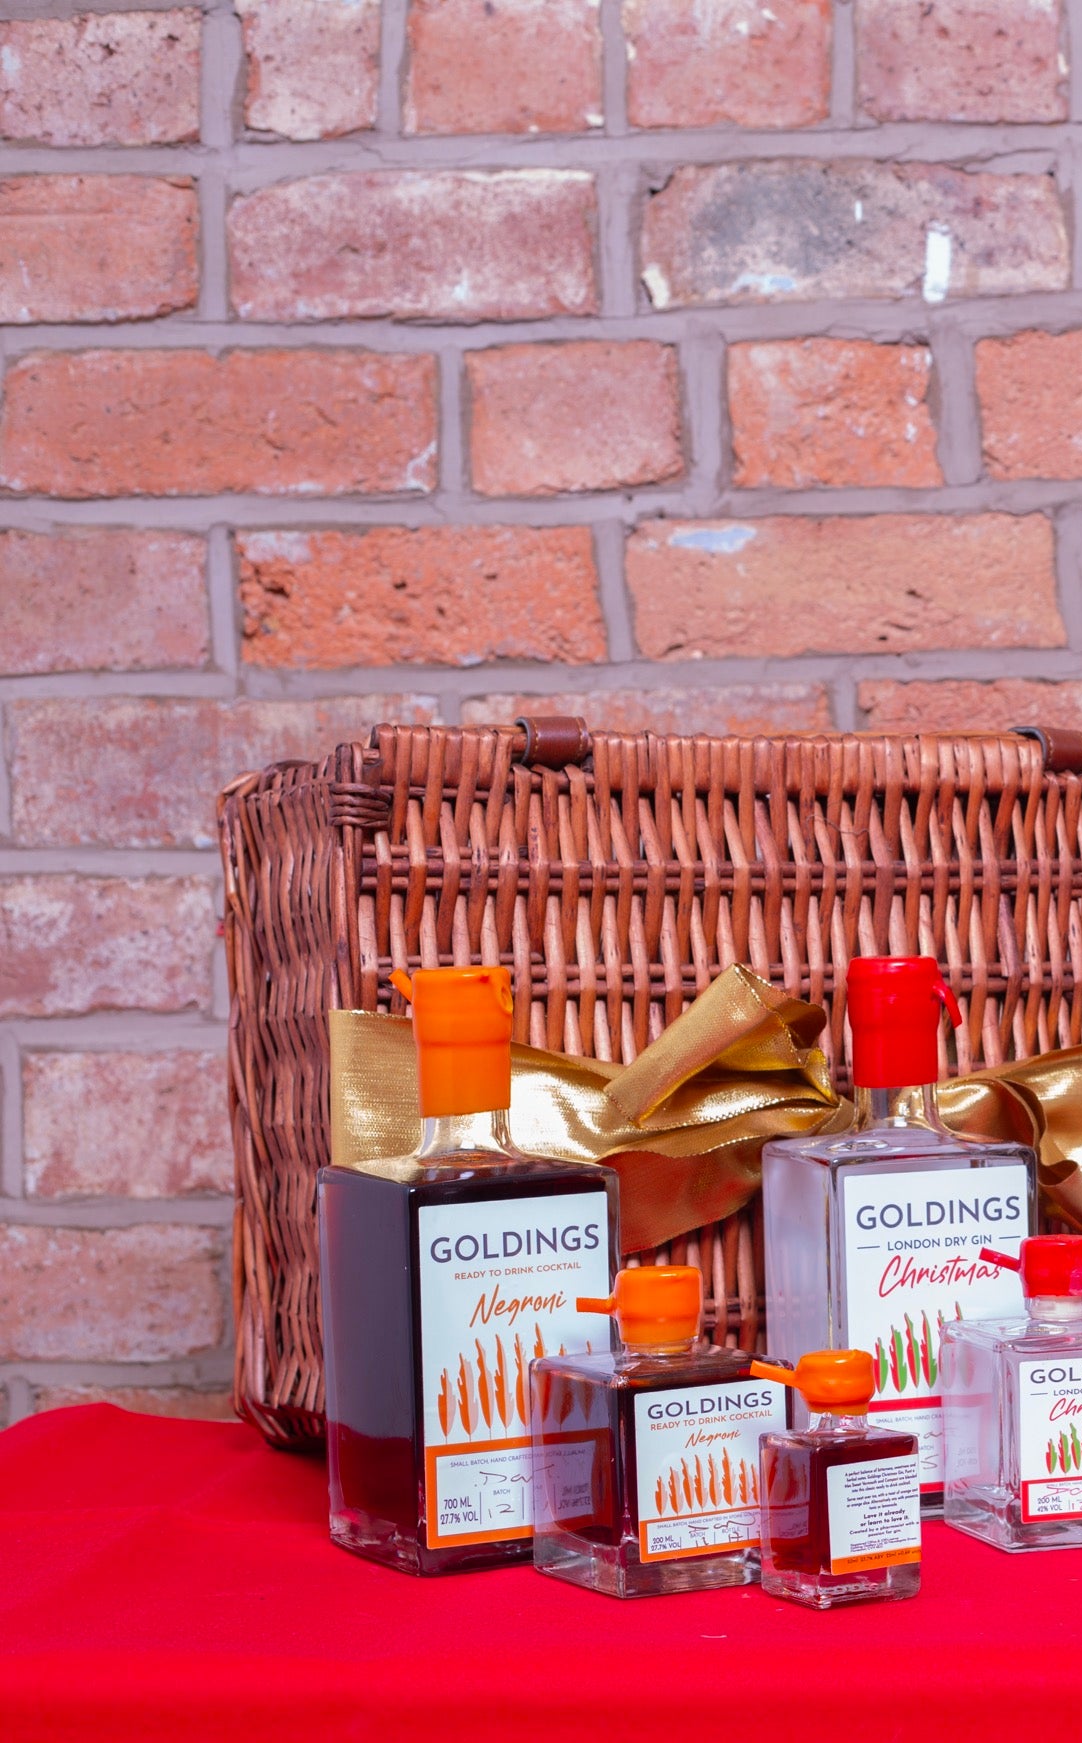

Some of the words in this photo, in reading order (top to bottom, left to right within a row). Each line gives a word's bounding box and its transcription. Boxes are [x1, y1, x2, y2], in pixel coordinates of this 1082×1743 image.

[856, 1196, 1020, 1230] GOLDINGS
[431, 1224, 599, 1263] GOLDINGS
[888, 1238, 940, 1251] LONDON
[945, 1237, 967, 1246] DRY
[971, 1235, 992, 1245] GIN
[455, 1271, 485, 1280] READY
[505, 1266, 533, 1276] DRINK
[537, 1263, 581, 1272] COCKTAIL
[879, 1255, 1002, 1298] Christmas
[469, 1284, 567, 1327] Negroni
[648, 1391, 772, 1419] GOLDINGS
[651, 1421, 680, 1431] READY
[698, 1416, 727, 1424] DRINK
[729, 1411, 772, 1421] COCKTAIL
[685, 1429, 742, 1448] Negroni
[470, 1458, 489, 1466] BATCH,
[509, 1453, 533, 1461] CRAFTED
[444, 1499, 458, 1509] 700
[460, 1496, 472, 1508] ML
[884, 1508, 905, 1516] already
[440, 1513, 460, 1525] 27.7%
[462, 1511, 478, 1522] VOL
